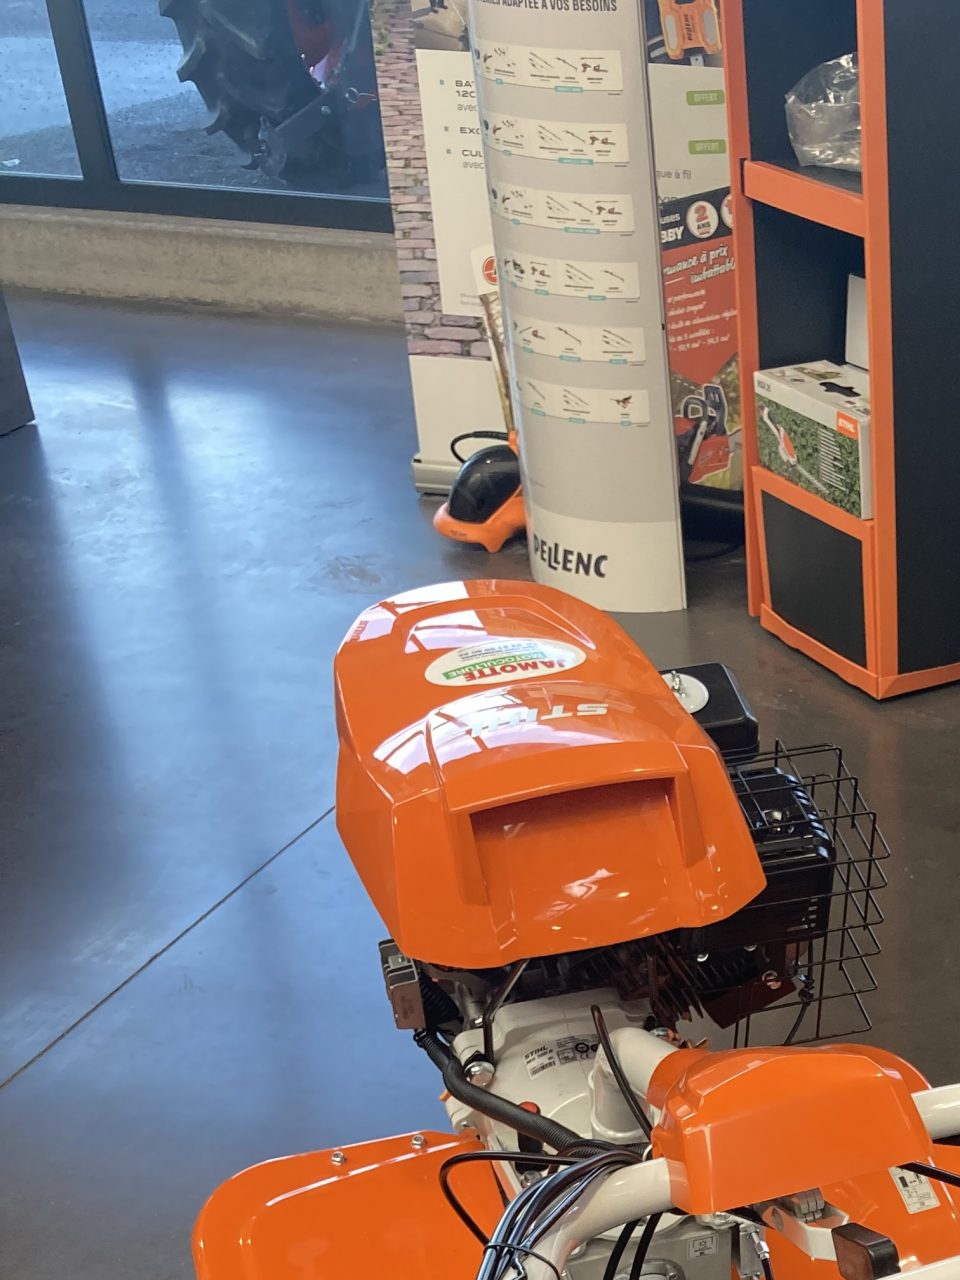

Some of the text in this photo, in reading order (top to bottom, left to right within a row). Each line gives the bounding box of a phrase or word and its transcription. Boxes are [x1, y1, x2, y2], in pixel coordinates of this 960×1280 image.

[551, 0, 570, 11] VOS
[572, 0, 618, 12] BESOINS
[694, 204, 709, 222] 2
[690, 257, 737, 284] imbattabl
[533, 532, 609, 578] PELLENC
[448, 652, 545, 677] MOTOCULTURE
[464, 659, 566, 682] JAMOTTE
[524, 1044, 549, 1060] STIHL
